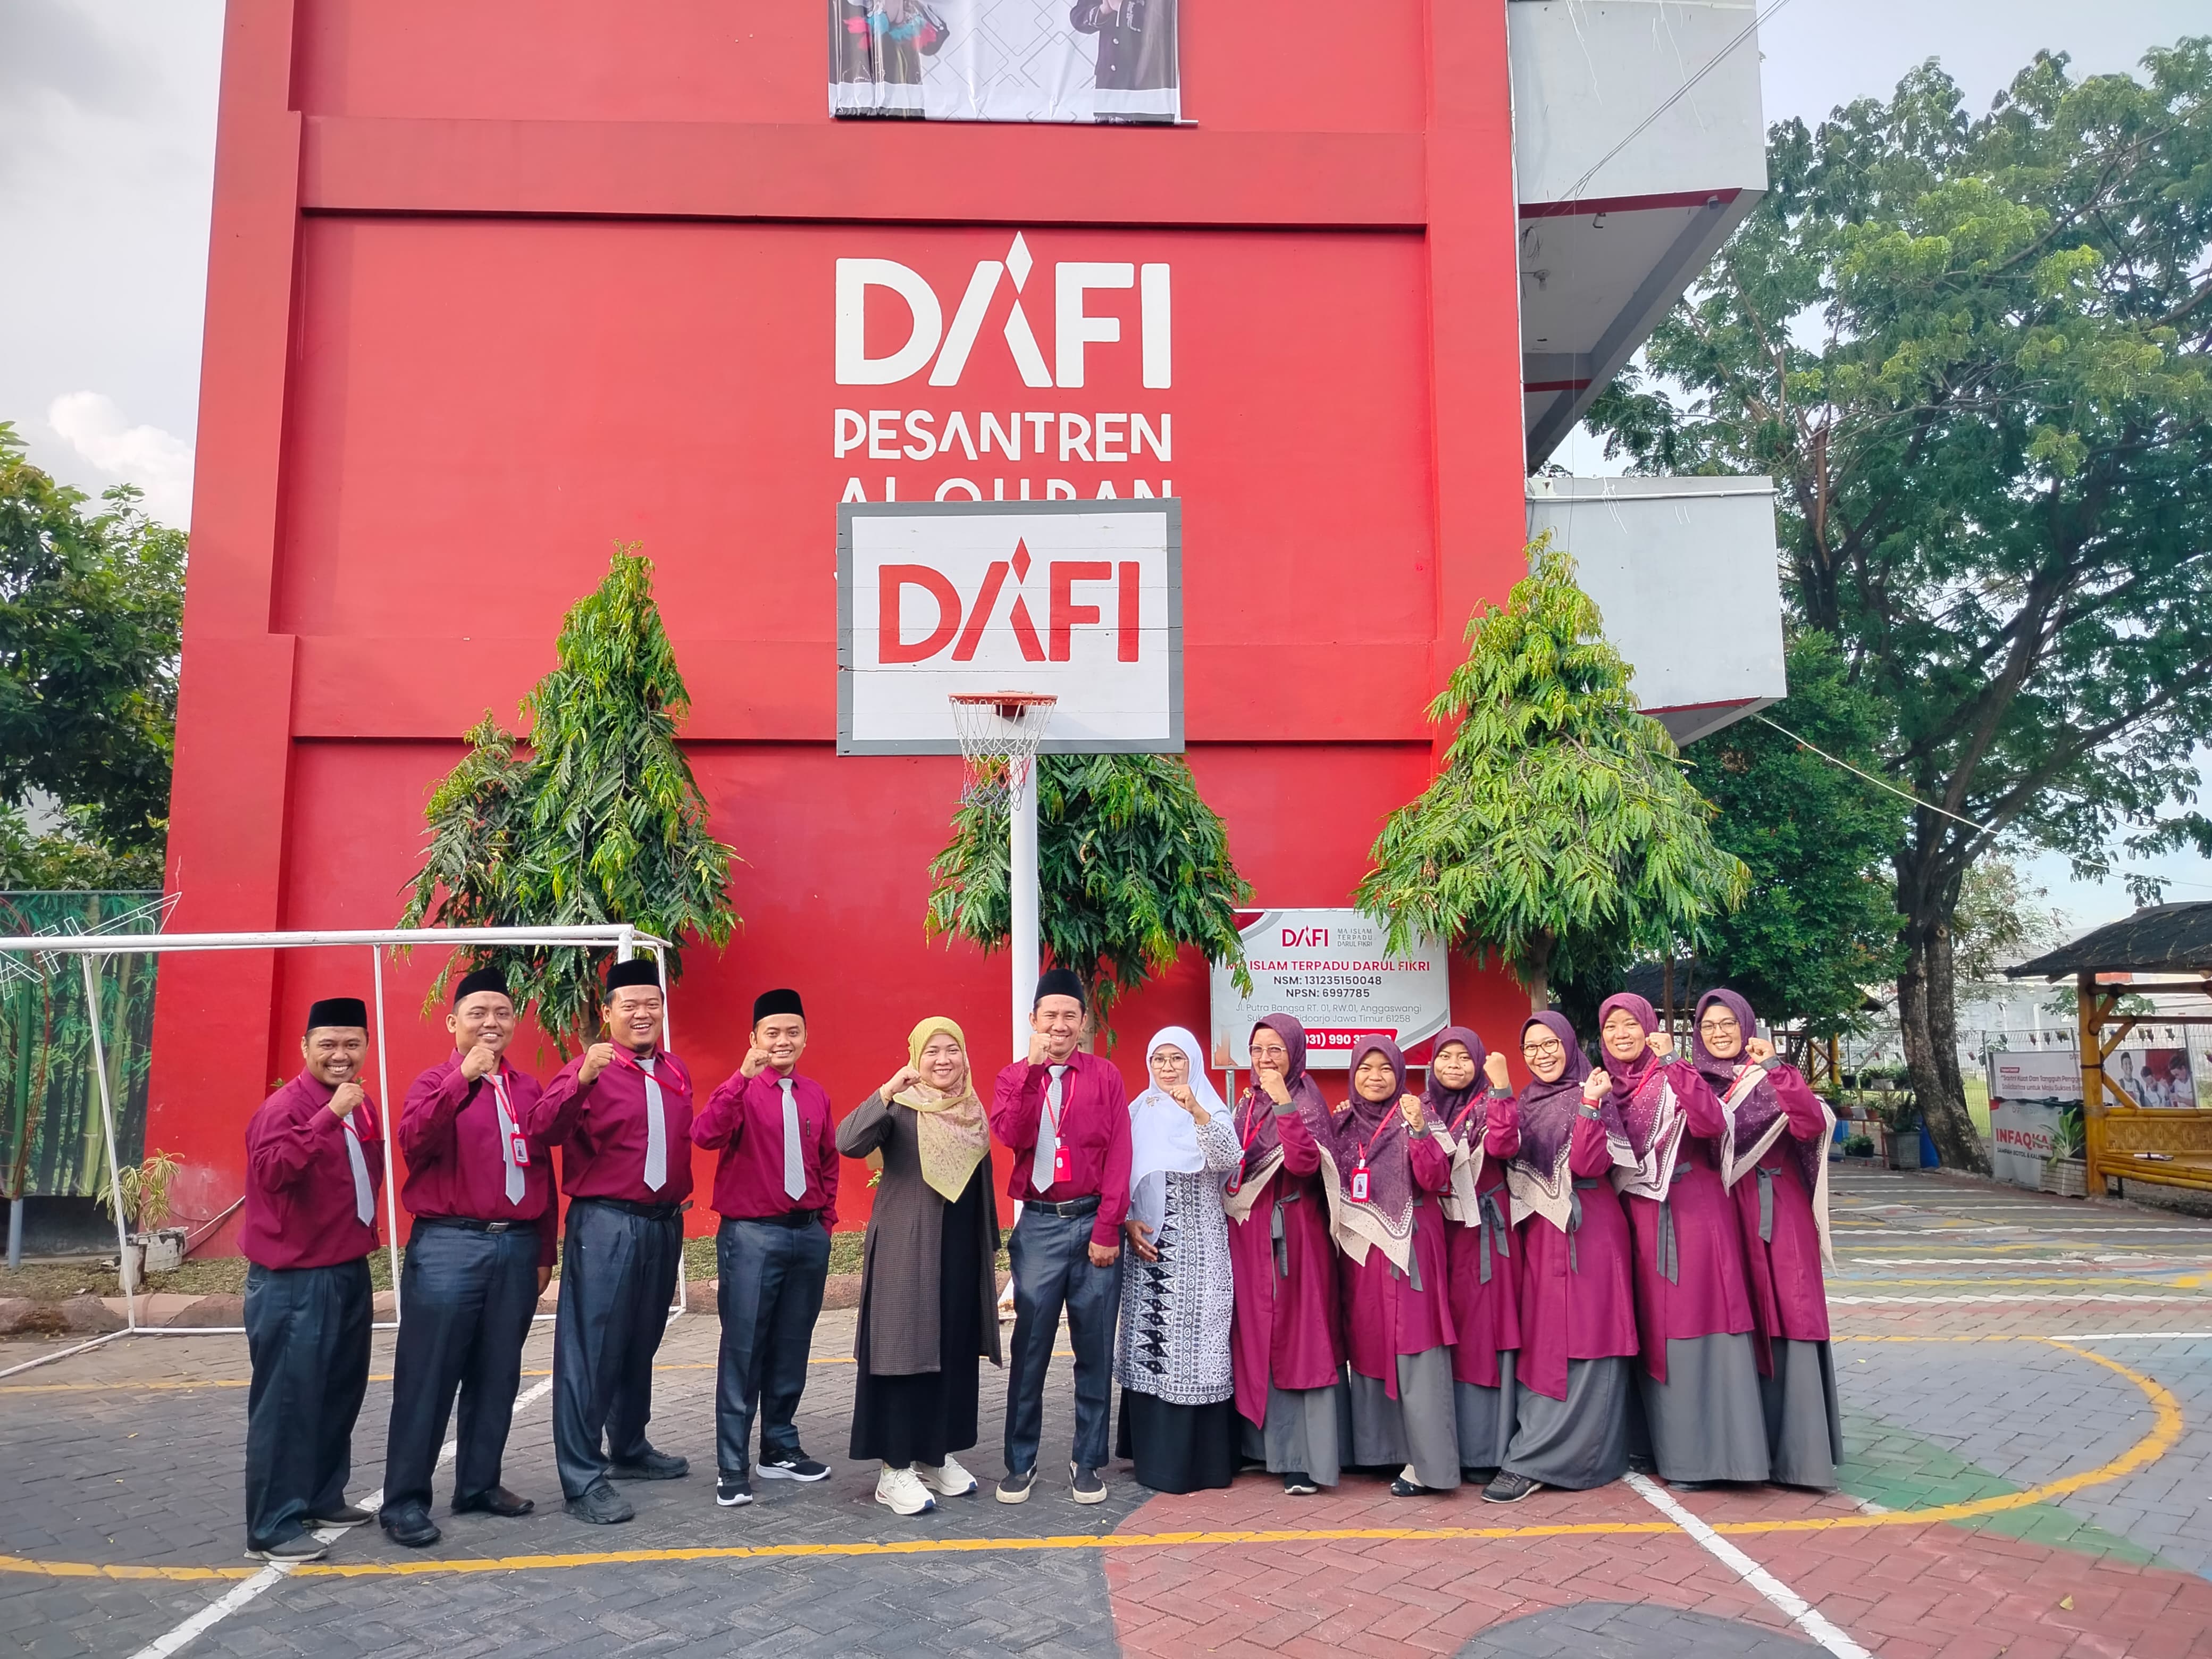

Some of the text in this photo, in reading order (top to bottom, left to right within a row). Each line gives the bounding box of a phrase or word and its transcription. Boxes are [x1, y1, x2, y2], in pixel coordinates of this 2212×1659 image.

[835, 231, 1171, 388] DAFI
[834, 409, 1171, 461] PESANTREN
[878, 536, 1139, 664] DAFI
[1282, 925, 1328, 947] DAFI
[1250, 960, 1288, 970] ISLAM
[1291, 961, 1350, 970] TERPADU
[1353, 961, 1395, 971] DARUL
[1398, 961, 1430, 971] FIKRI
[1273, 976, 1382, 985] NSM: 131235150048
[1286, 988, 1370, 998] NPSN: 6997785
[1271, 1004, 1304, 1013] Bangsa
[1360, 1004, 1422, 1015] Anggaswangi
[1329, 1034, 1351, 1045] 990
[1996, 1128, 2053, 1150] INFAQKA
